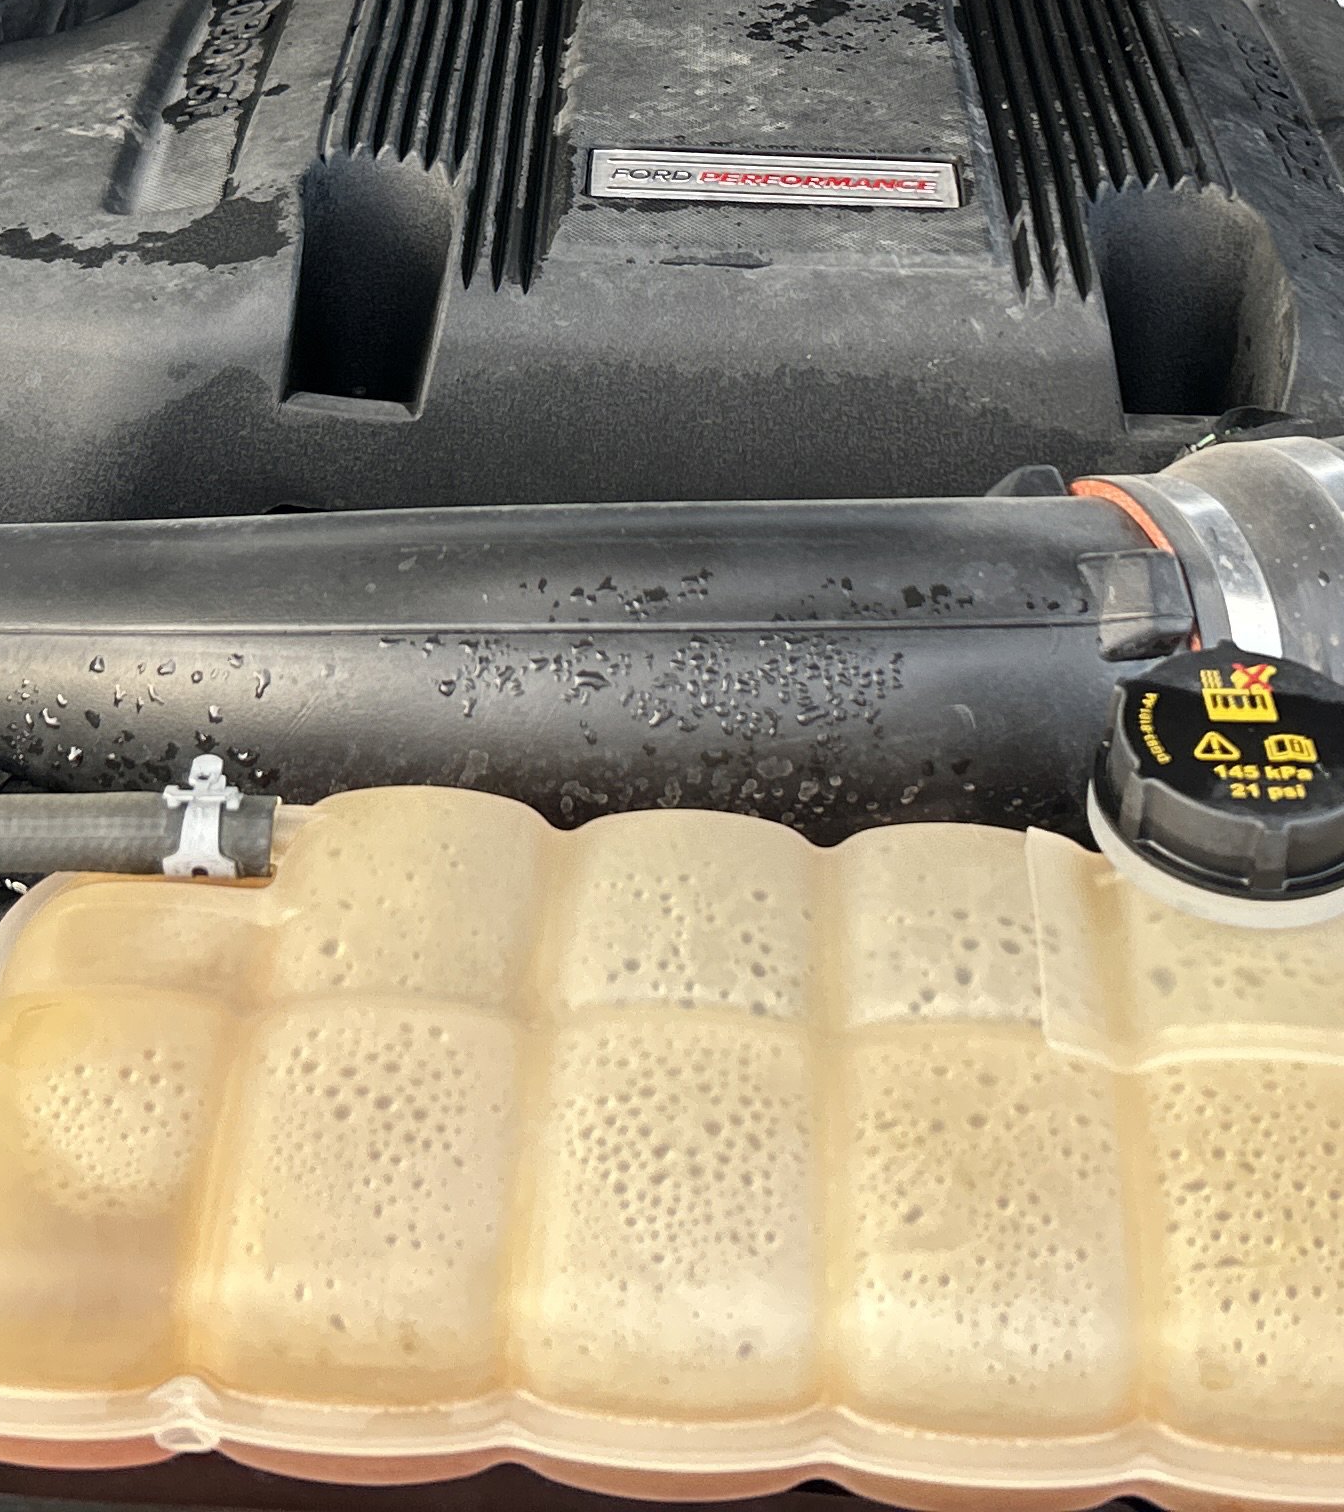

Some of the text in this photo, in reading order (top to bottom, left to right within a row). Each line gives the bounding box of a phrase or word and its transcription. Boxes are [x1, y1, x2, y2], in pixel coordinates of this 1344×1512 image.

[610, 167, 937, 194] FORD PERFORMANCE
[1213, 764, 1314, 782] 145 kPa
[1229, 783, 1307, 802] 21 psi
